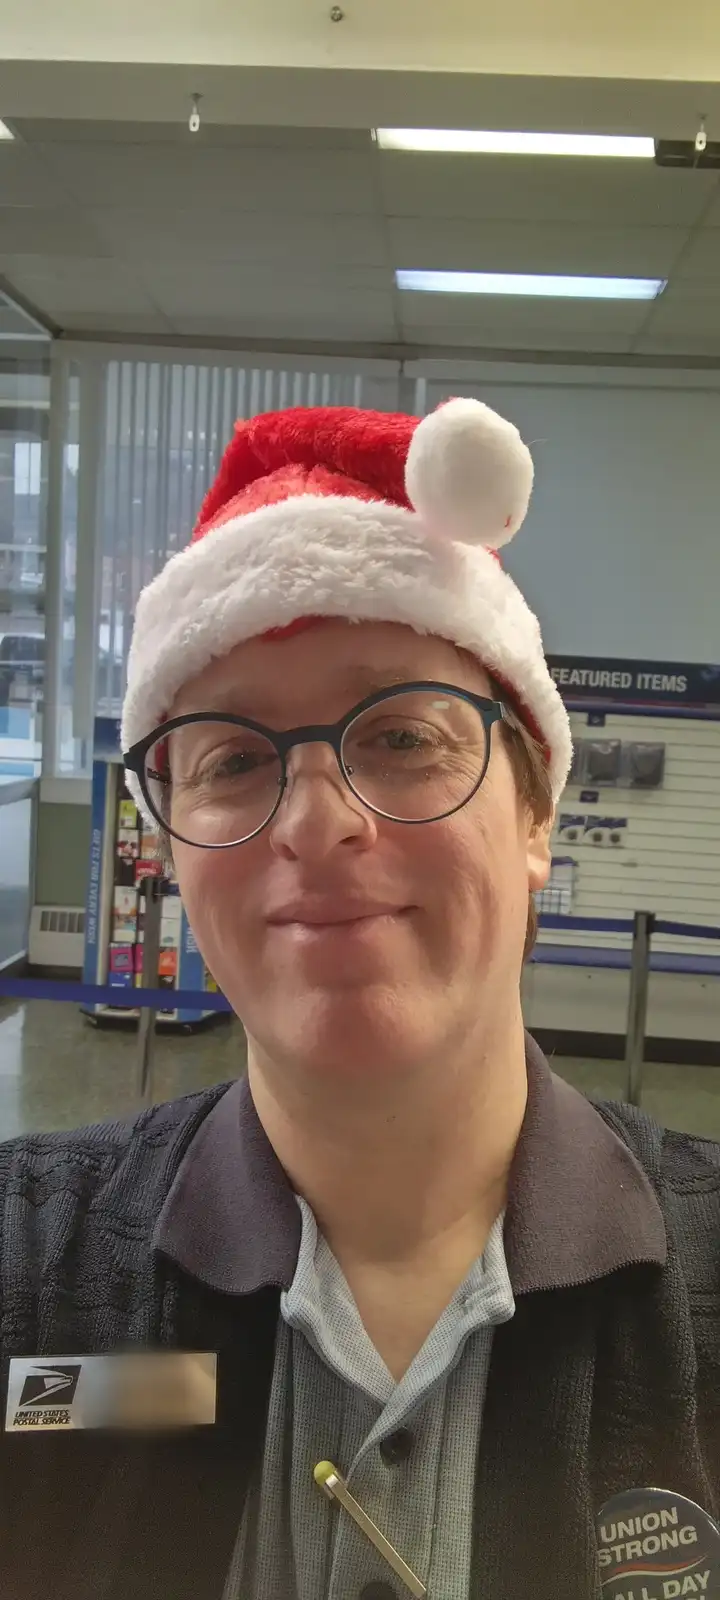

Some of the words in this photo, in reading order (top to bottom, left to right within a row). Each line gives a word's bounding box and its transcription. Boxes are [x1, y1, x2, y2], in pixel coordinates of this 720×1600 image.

[550, 667, 632, 689] FEATURED
[636, 672, 688, 692] ITEMS
[13, 1417, 41, 1426] POSTAL
[41, 1416, 71, 1425] SERVICE
[15, 1410, 43, 1418] UNITED
[43, 1409, 70, 1417] STATES
[600, 1506, 679, 1543] UNION
[596, 1525, 698, 1568] STRONG
[662, 1569, 711, 1600] DAY
